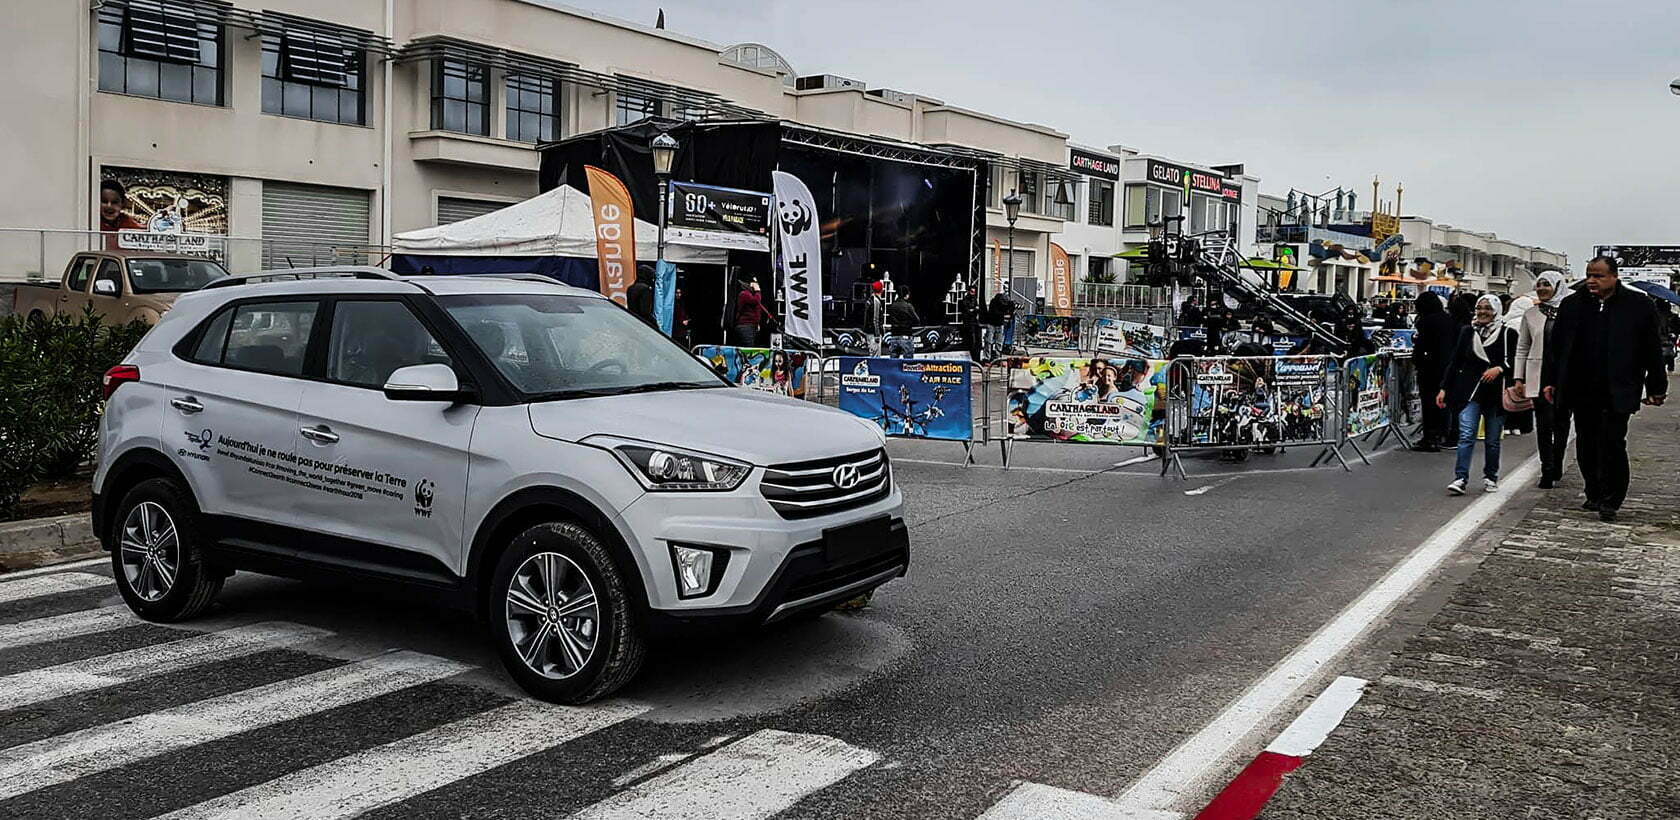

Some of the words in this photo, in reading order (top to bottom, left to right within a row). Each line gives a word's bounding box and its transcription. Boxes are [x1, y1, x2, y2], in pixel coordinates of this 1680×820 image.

[1073, 154, 1103, 170] CARTHAGE
[1103, 161, 1118, 175] LAND
[1153, 164, 1180, 183] GELATO
[1192, 173, 1221, 192] STELLINA
[1222, 187, 1238, 199] LOUNGE
[788, 252, 809, 321] WWF
[925, 363, 963, 373] Attraction
[942, 376, 961, 384] RACE
[1049, 403, 1120, 414] CARTHAGELAND
[1076, 423, 1089, 433] est
[1089, 424, 1119, 434] partout
[187, 451, 210, 461] HYUNDAI
[218, 435, 259, 454] Aujourd'hui
[259, 443, 266, 456] je
[266, 449, 277, 458] ne
[277, 449, 297, 463] roule
[297, 456, 313, 467] pas
[313, 460, 333, 472] pour
[334, 464, 374, 481] préserver
[375, 471, 383, 482] la
[384, 473, 407, 488] Terre
[382, 488, 404, 501] #caring
[414, 506, 433, 518] WWF
